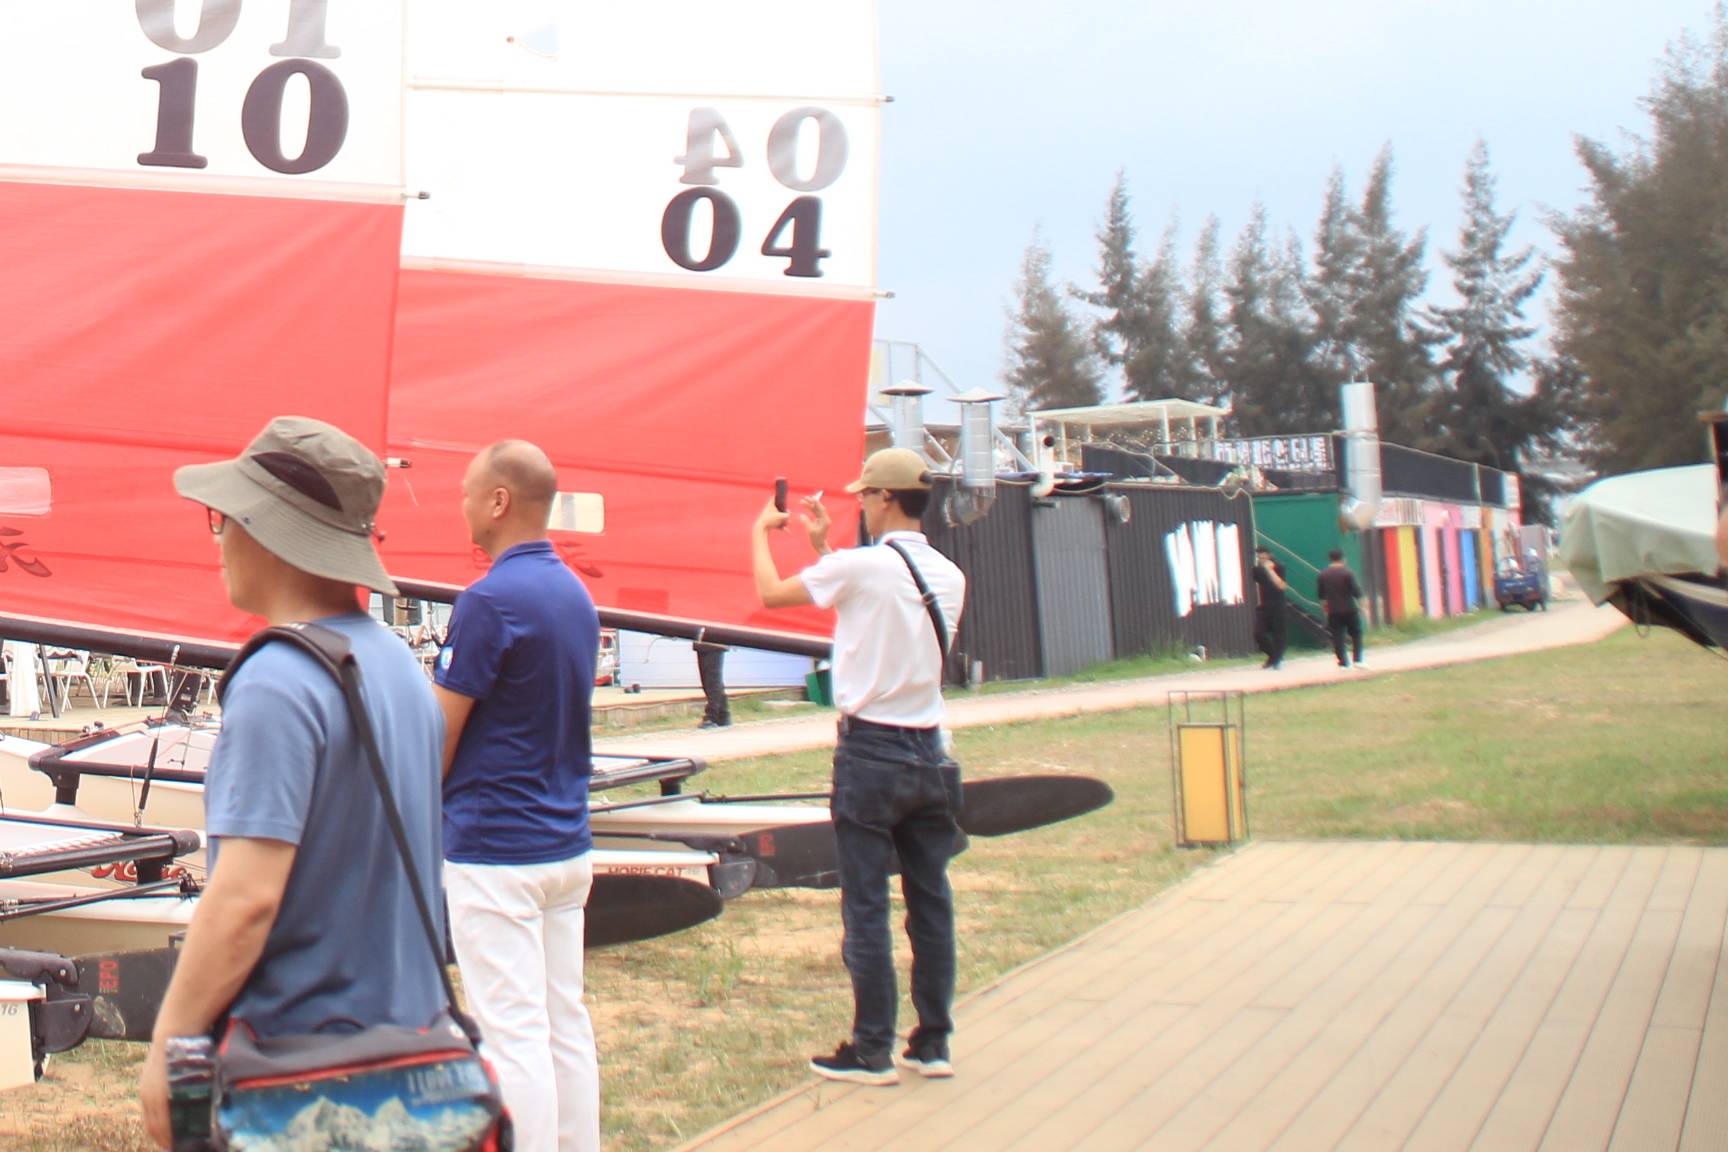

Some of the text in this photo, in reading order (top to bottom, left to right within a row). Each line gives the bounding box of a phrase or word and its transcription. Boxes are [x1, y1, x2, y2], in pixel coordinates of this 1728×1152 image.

[136, 57, 350, 175] 10
[661, 186, 832, 279] 04
[1, 1003, 19, 1016] 16
